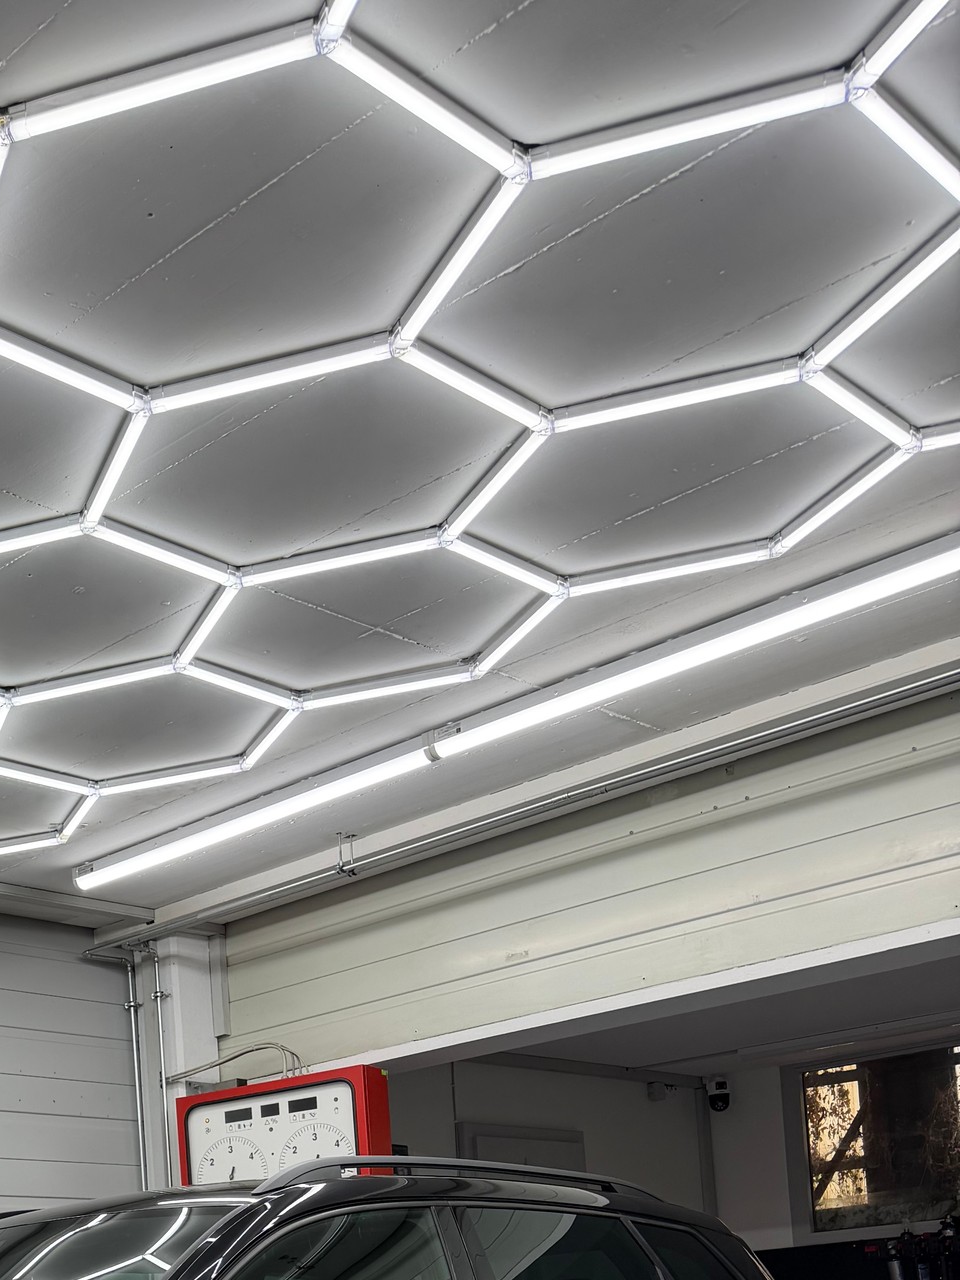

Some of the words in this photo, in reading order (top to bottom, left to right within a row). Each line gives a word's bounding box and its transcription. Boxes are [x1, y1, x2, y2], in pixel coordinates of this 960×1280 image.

[292, 1146, 298, 1154] 2
[312, 1132, 318, 1141] 3
[334, 1139, 340, 1148] 4
[209, 1158, 215, 1167] 2
[227, 1145, 233, 1154] 3
[248, 1152, 254, 1160] 4
